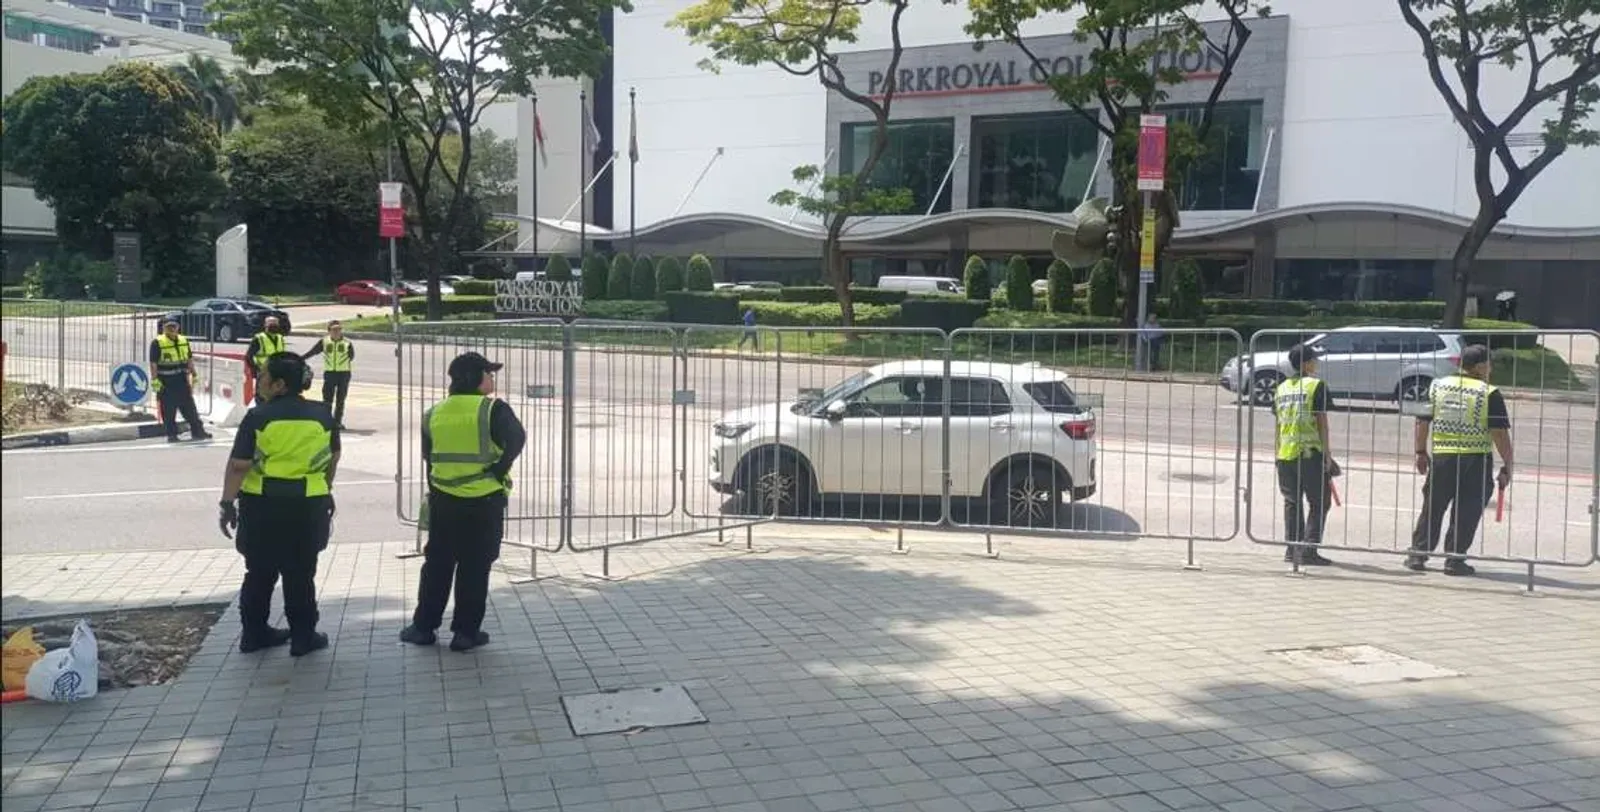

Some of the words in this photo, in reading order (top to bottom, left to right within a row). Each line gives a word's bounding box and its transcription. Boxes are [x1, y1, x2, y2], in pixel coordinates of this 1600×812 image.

[868, 60, 1021, 95] PARKROYAL
[1029, 45, 1227, 84] COLTION
[494, 279, 583, 298] PARKROYAL
[495, 294, 584, 315] COLLECTION
